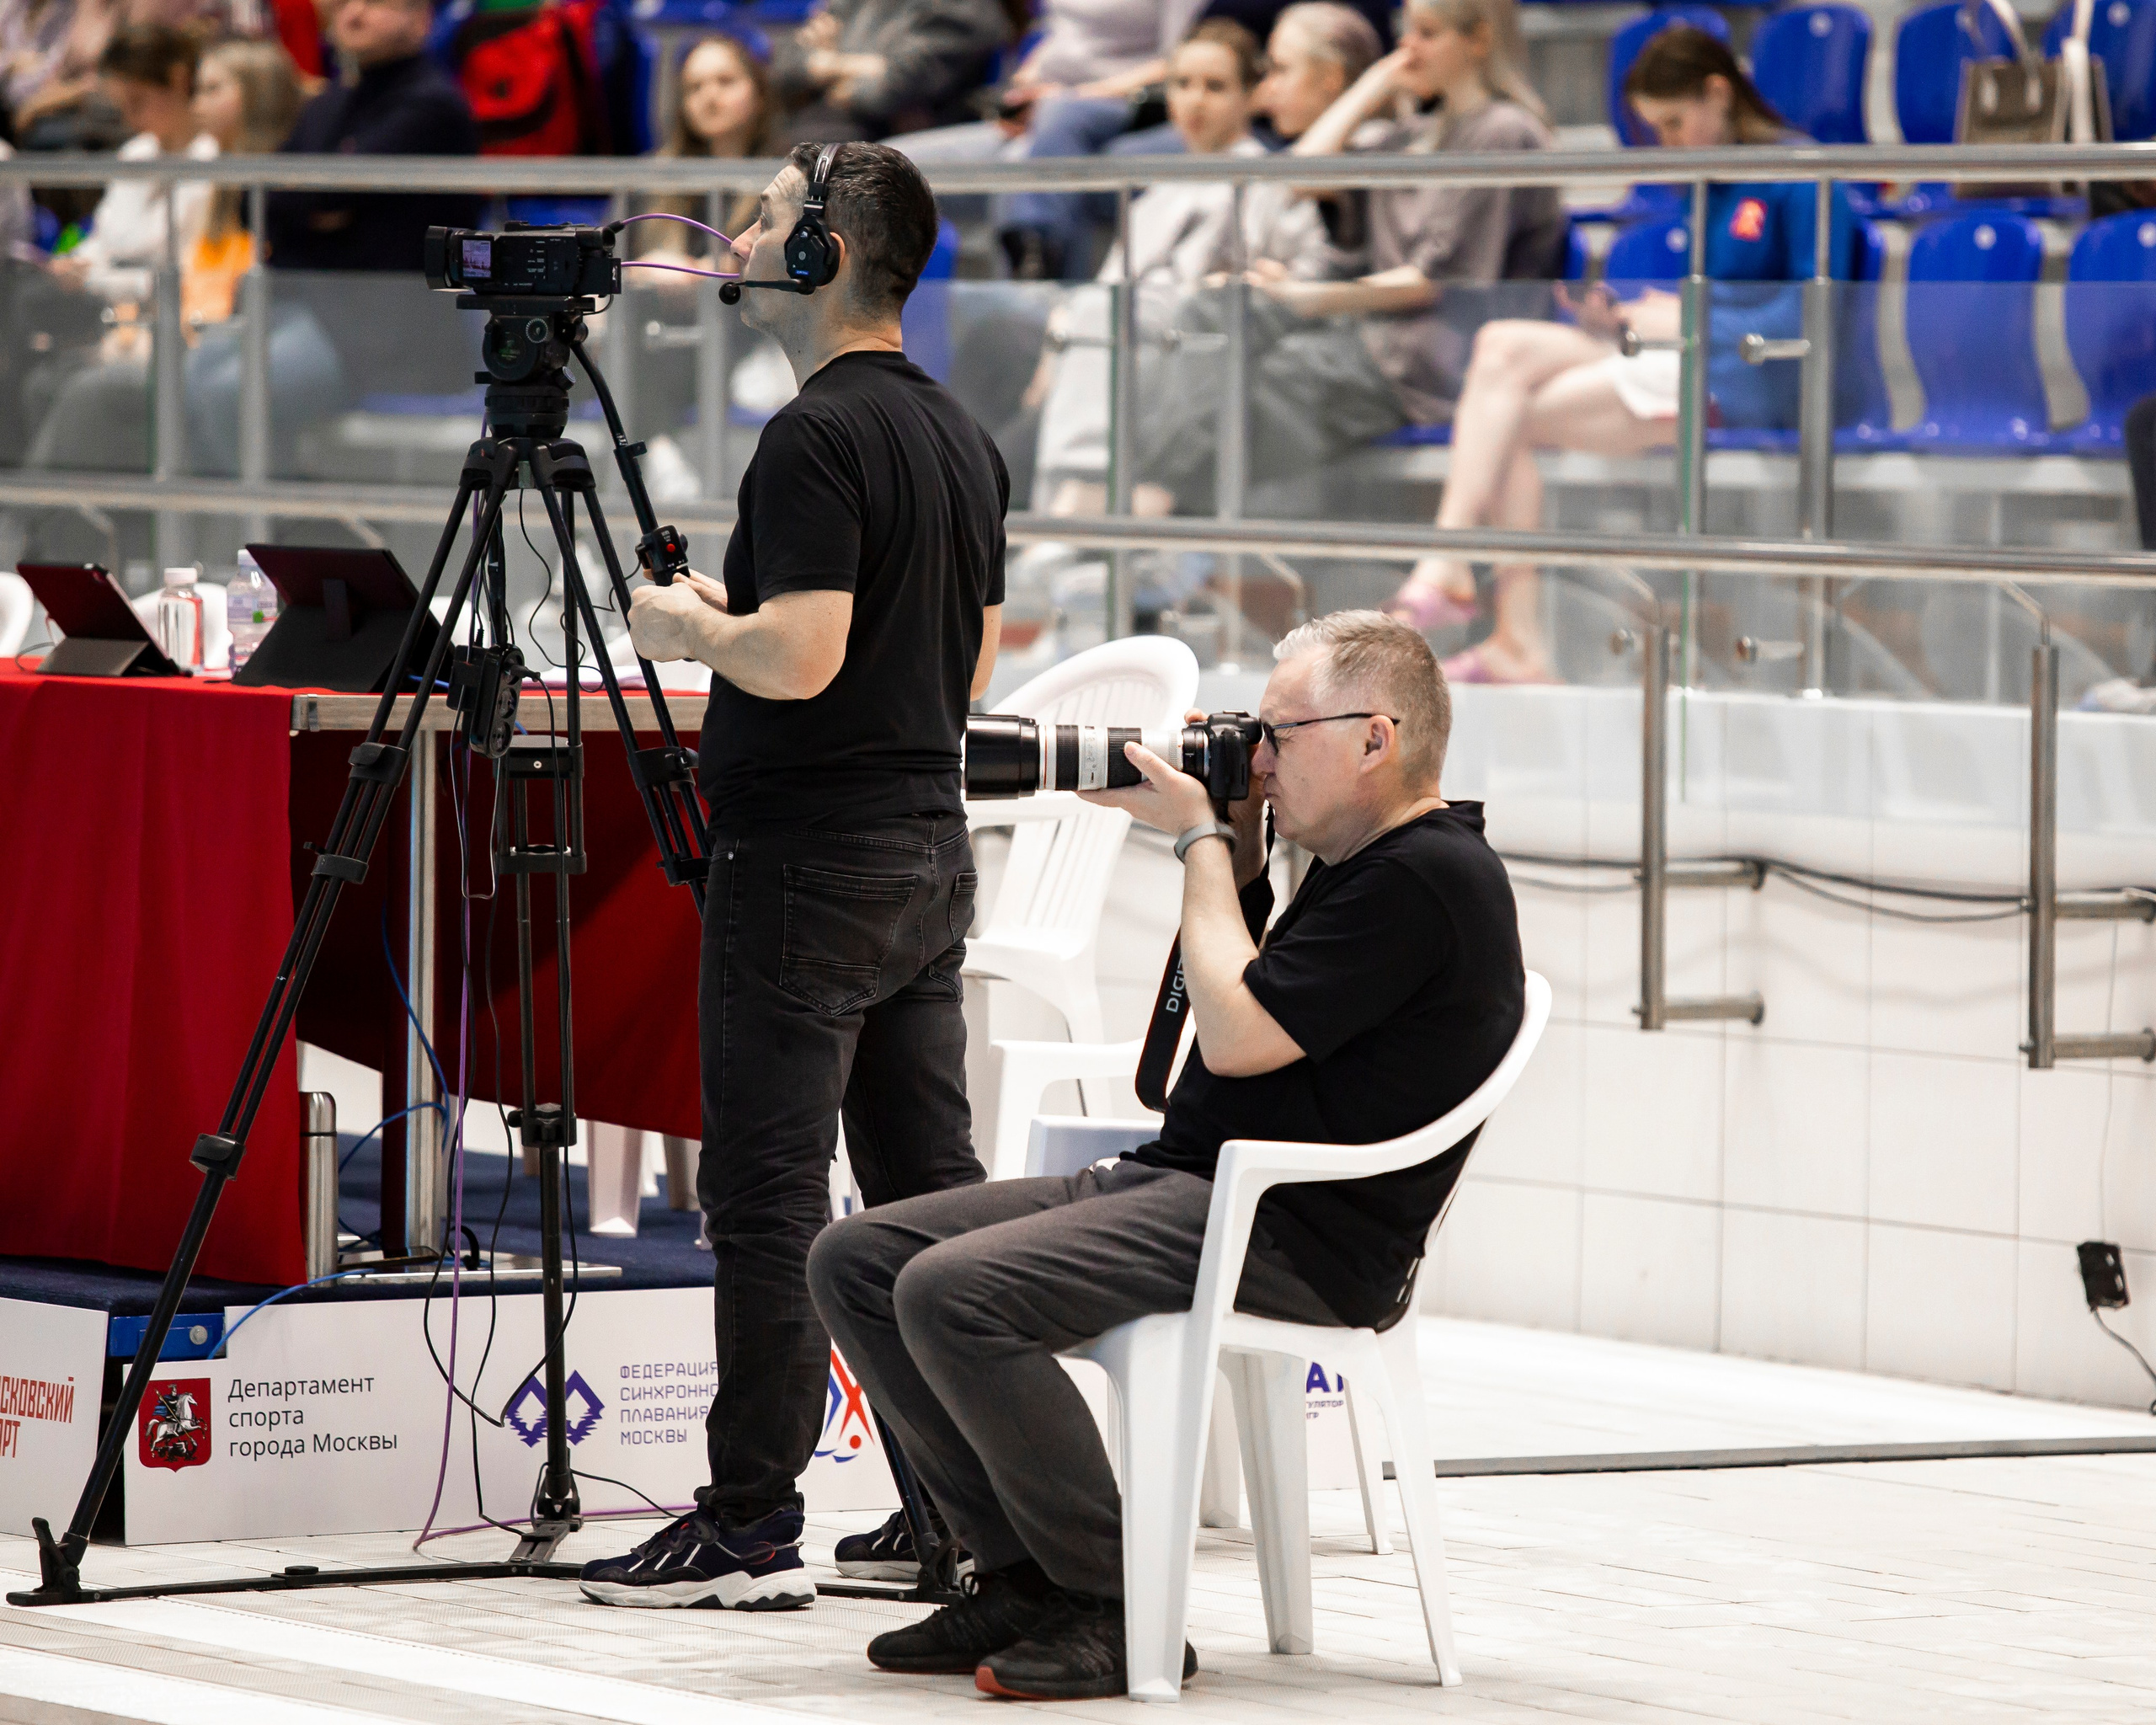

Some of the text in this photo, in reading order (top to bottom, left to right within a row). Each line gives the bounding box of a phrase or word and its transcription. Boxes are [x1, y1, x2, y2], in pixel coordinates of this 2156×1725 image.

[620, 1361, 718, 1379] ФЕДЕРАЦИЯ
[0, 1375, 75, 1423] СКОВСКИЙ
[228, 1377, 375, 1402] Департамент
[229, 1409, 304, 1432] спорта
[620, 1406, 709, 1423] ПЛАВАНИЯ
[230, 1434, 397, 1461] города Москвы
[621, 1429, 686, 1445] МОСКВЫ
